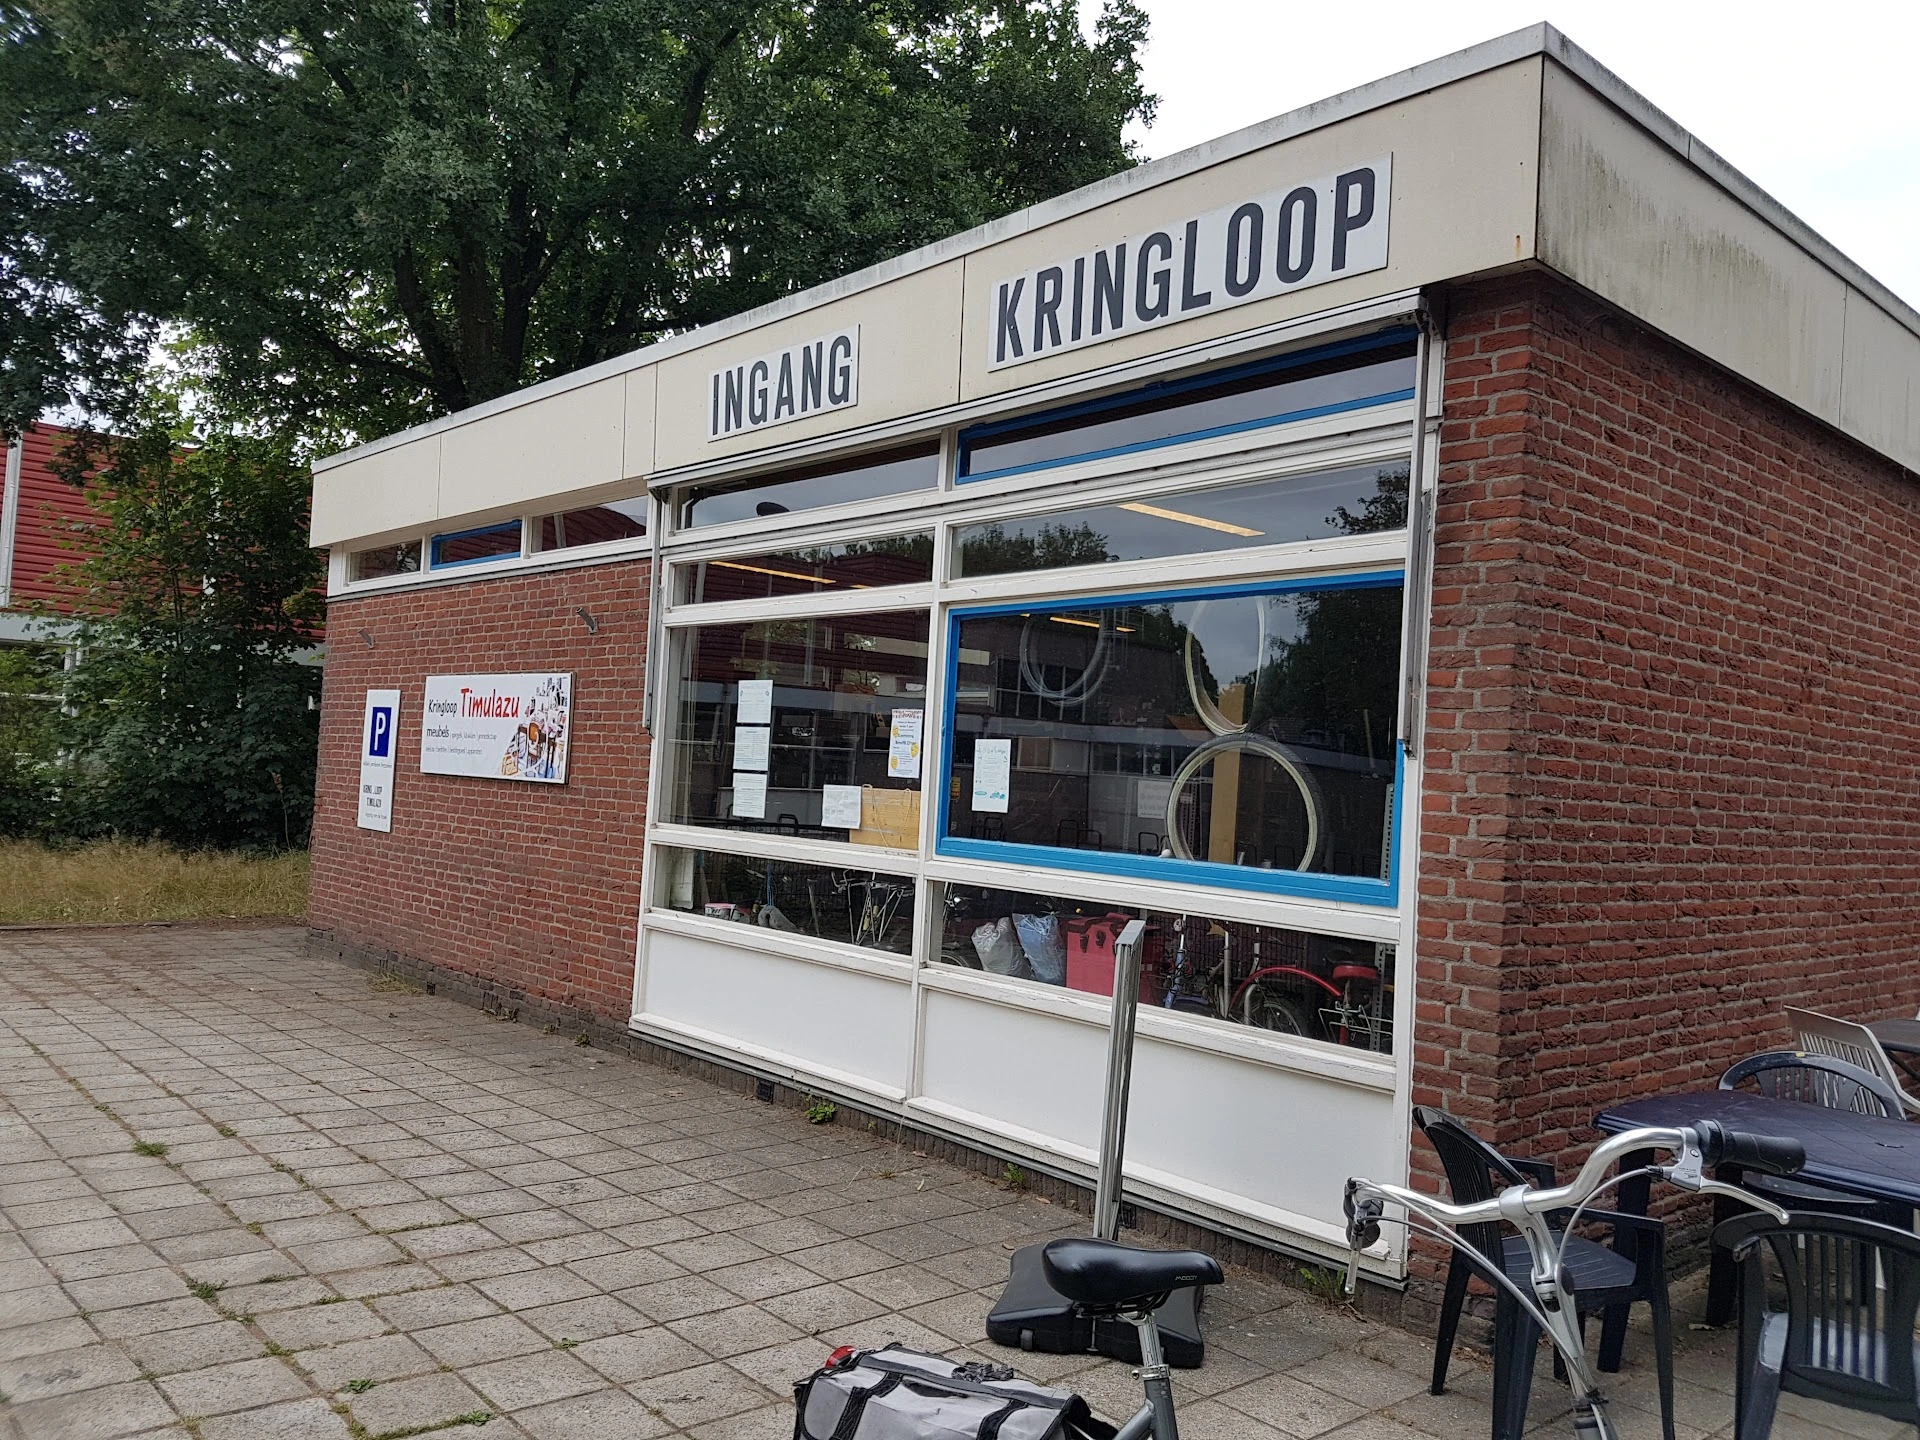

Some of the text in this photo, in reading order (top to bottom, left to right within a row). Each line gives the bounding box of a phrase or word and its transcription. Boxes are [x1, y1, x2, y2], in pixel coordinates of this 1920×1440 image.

[713, 168, 1376, 436] INGANG KRINGLOOP
[428, 687, 520, 718] Kringloop Timulazu
[374, 711, 387, 751] P
[426, 724, 450, 738] meubels
